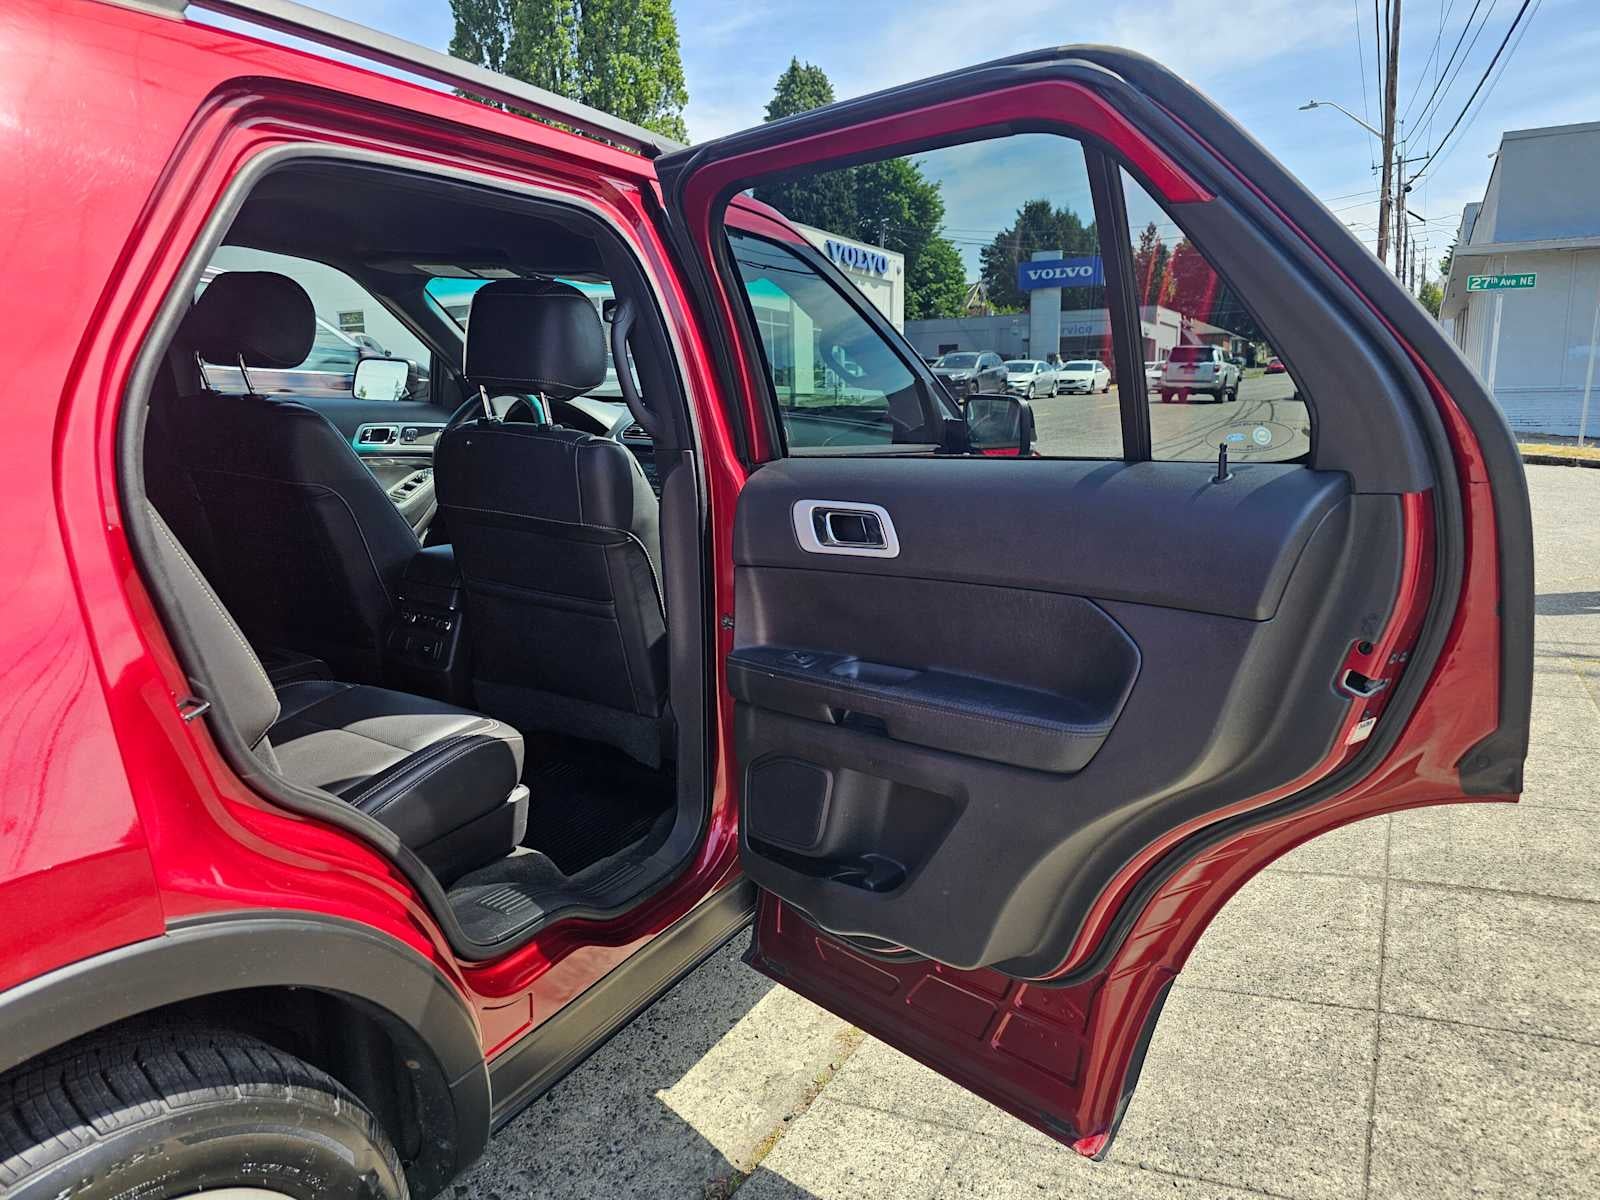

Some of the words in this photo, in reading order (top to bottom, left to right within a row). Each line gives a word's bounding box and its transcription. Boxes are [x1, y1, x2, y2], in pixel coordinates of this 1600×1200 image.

[826, 240, 888, 273] VOLVO
[1027, 265, 1093, 280] VOLVO
[1470, 277, 1498, 289] 27th
[1500, 278, 1517, 286] Ave
[1520, 276, 1534, 285] NE
[1062, 323, 1093, 335] rvice
